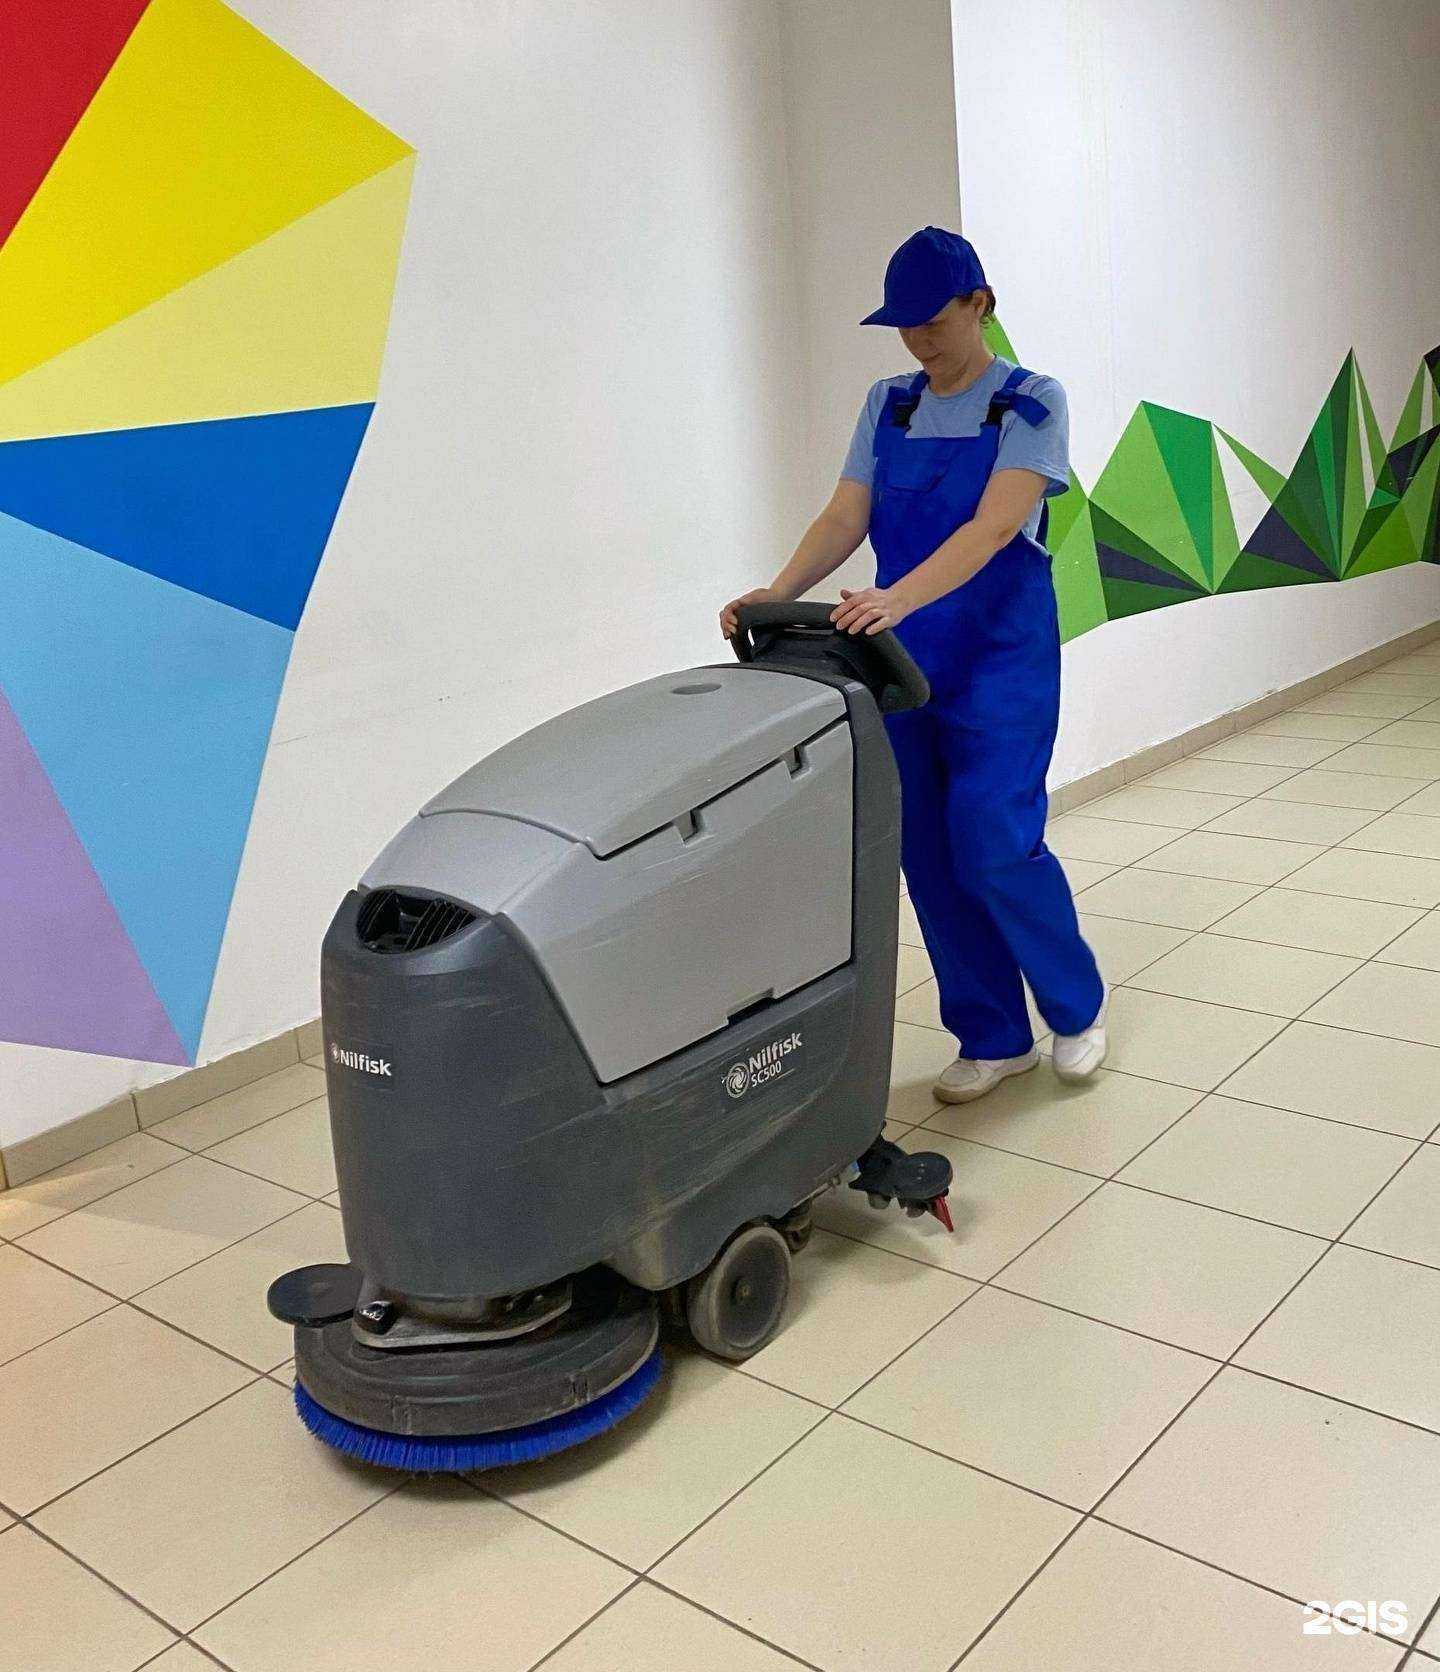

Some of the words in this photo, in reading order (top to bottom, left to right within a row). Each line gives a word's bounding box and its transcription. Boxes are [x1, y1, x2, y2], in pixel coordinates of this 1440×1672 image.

[340, 1049, 392, 1076] Nilfisk
[748, 1032, 802, 1073] Nilfisk
[751, 1060, 782, 1088] SC500
